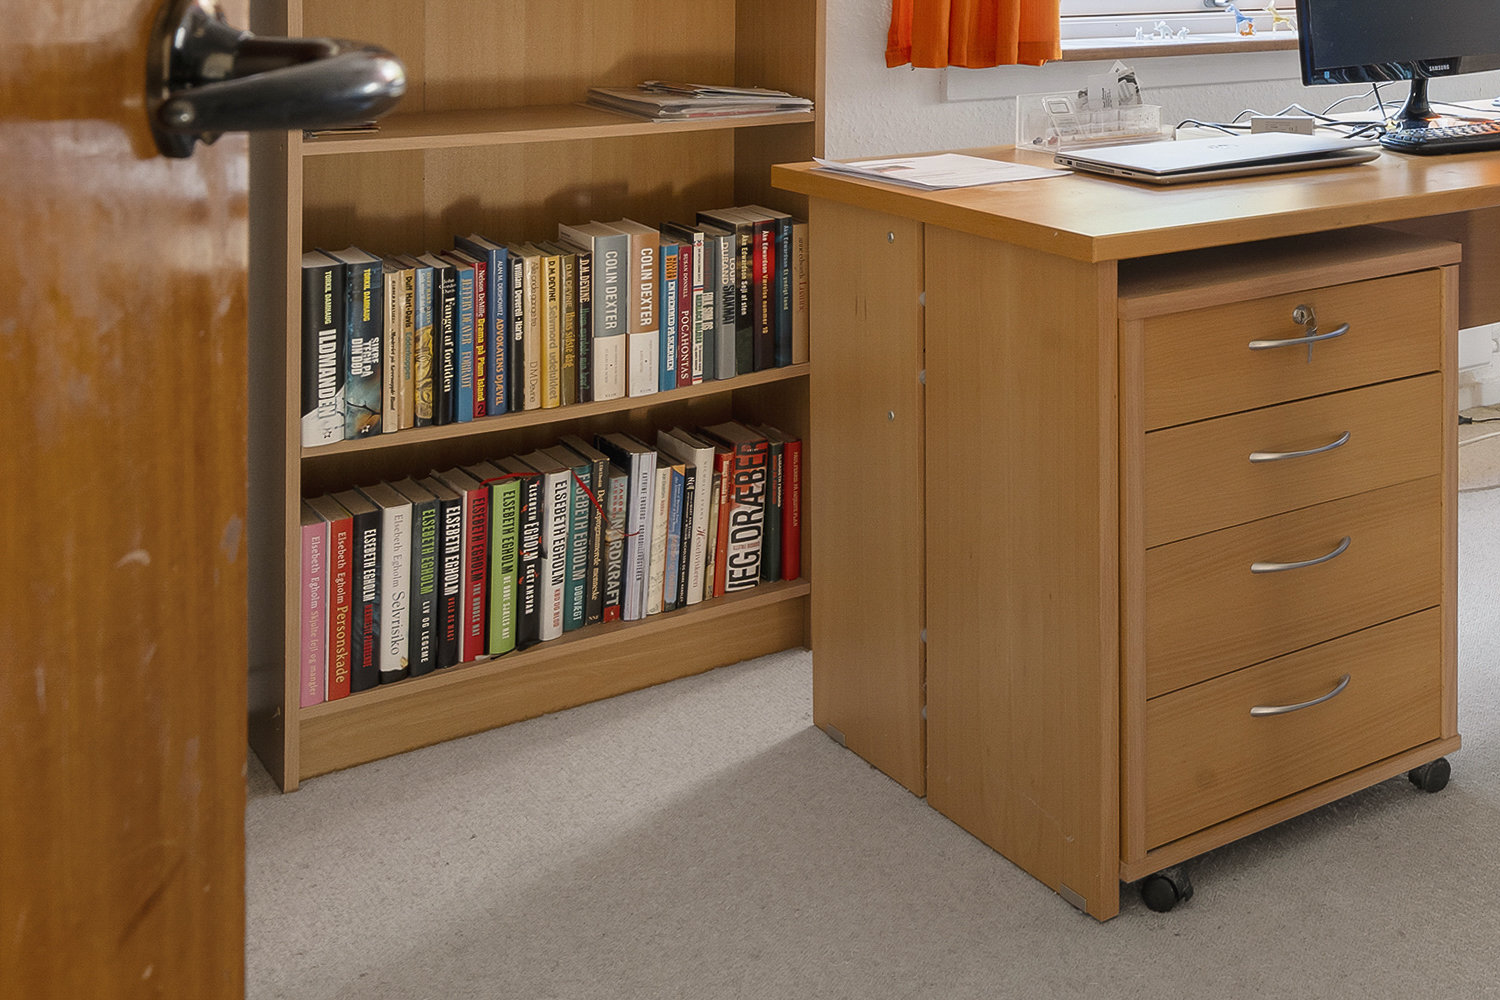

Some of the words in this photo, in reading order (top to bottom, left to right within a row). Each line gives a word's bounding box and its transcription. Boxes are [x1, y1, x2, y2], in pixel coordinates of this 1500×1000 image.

[605, 251, 617, 285] COLIN
[640, 248, 653, 281] COLIN
[605, 287, 617, 329] DEXTER
[640, 283, 653, 326] DEXTER
[722, 285, 735, 325] SKAKMAT
[496, 318, 504, 372] ADVOKATENS
[681, 310, 689, 379] POCAHONTAS
[318, 328, 336, 419] ILDMANDEN
[731, 439, 768, 546] DRÆBER
[337, 532, 346, 569] Elsebeth
[393, 514, 403, 551] Elsebeth
[311, 536, 320, 573] Elsebeth
[391, 554, 402, 588] Egholm
[572, 533, 588, 581] EGHOLM
[727, 550, 760, 592] JEG
[309, 577, 320, 608] Egholm
[335, 573, 345, 604] Egholm
[335, 606, 348, 683] Personskade
[390, 591, 405, 656] Selvrisiko
